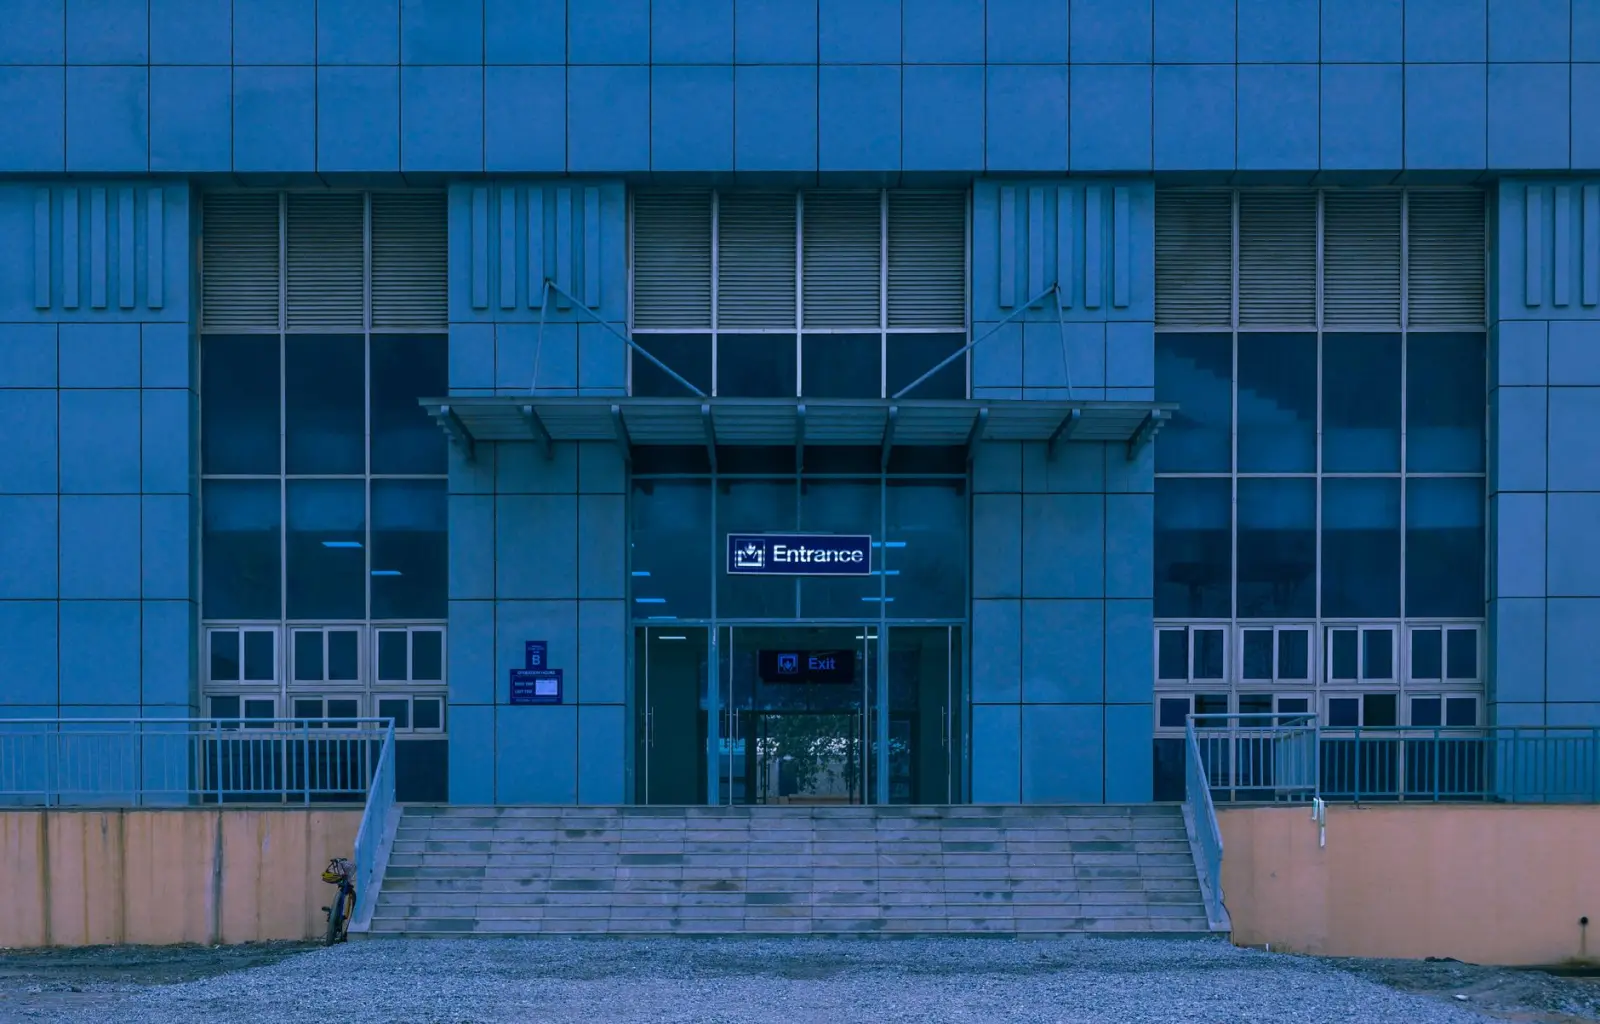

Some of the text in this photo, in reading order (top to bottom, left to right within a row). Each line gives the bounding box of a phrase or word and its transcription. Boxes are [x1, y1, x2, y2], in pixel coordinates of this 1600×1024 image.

[773, 544, 863, 563] Entrance
[532, 655, 540, 665] B
[808, 657, 836, 670] Exit
